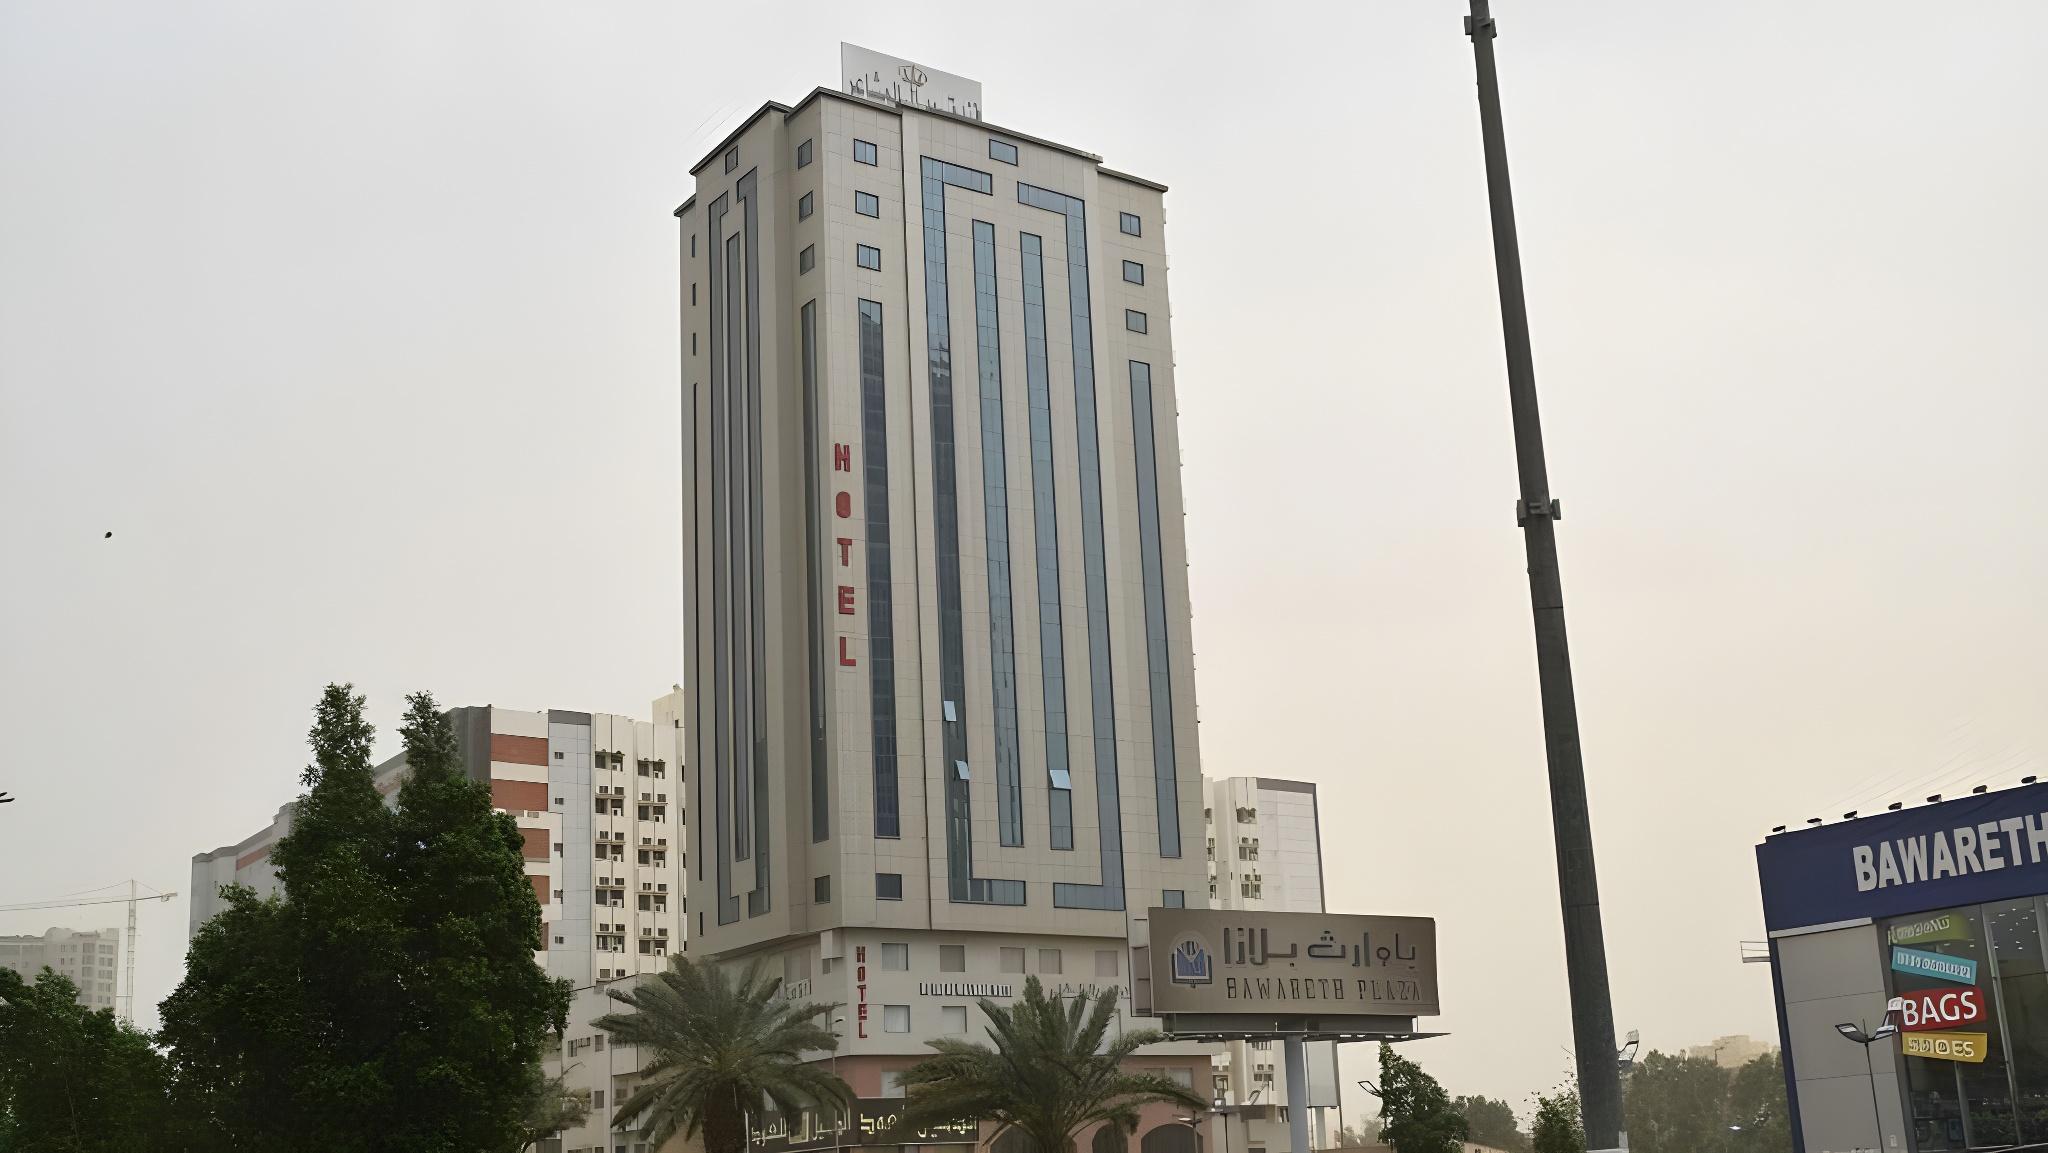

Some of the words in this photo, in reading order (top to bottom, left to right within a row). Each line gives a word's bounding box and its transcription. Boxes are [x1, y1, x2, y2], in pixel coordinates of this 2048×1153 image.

[834, 443, 857, 667] HOTEL
[1853, 811, 2048, 892] BAWARETH
[856, 946, 868, 1038] HOTEL
[1357, 979, 1421, 1001] PLAZA
[1902, 991, 1978, 1026] BAGS
